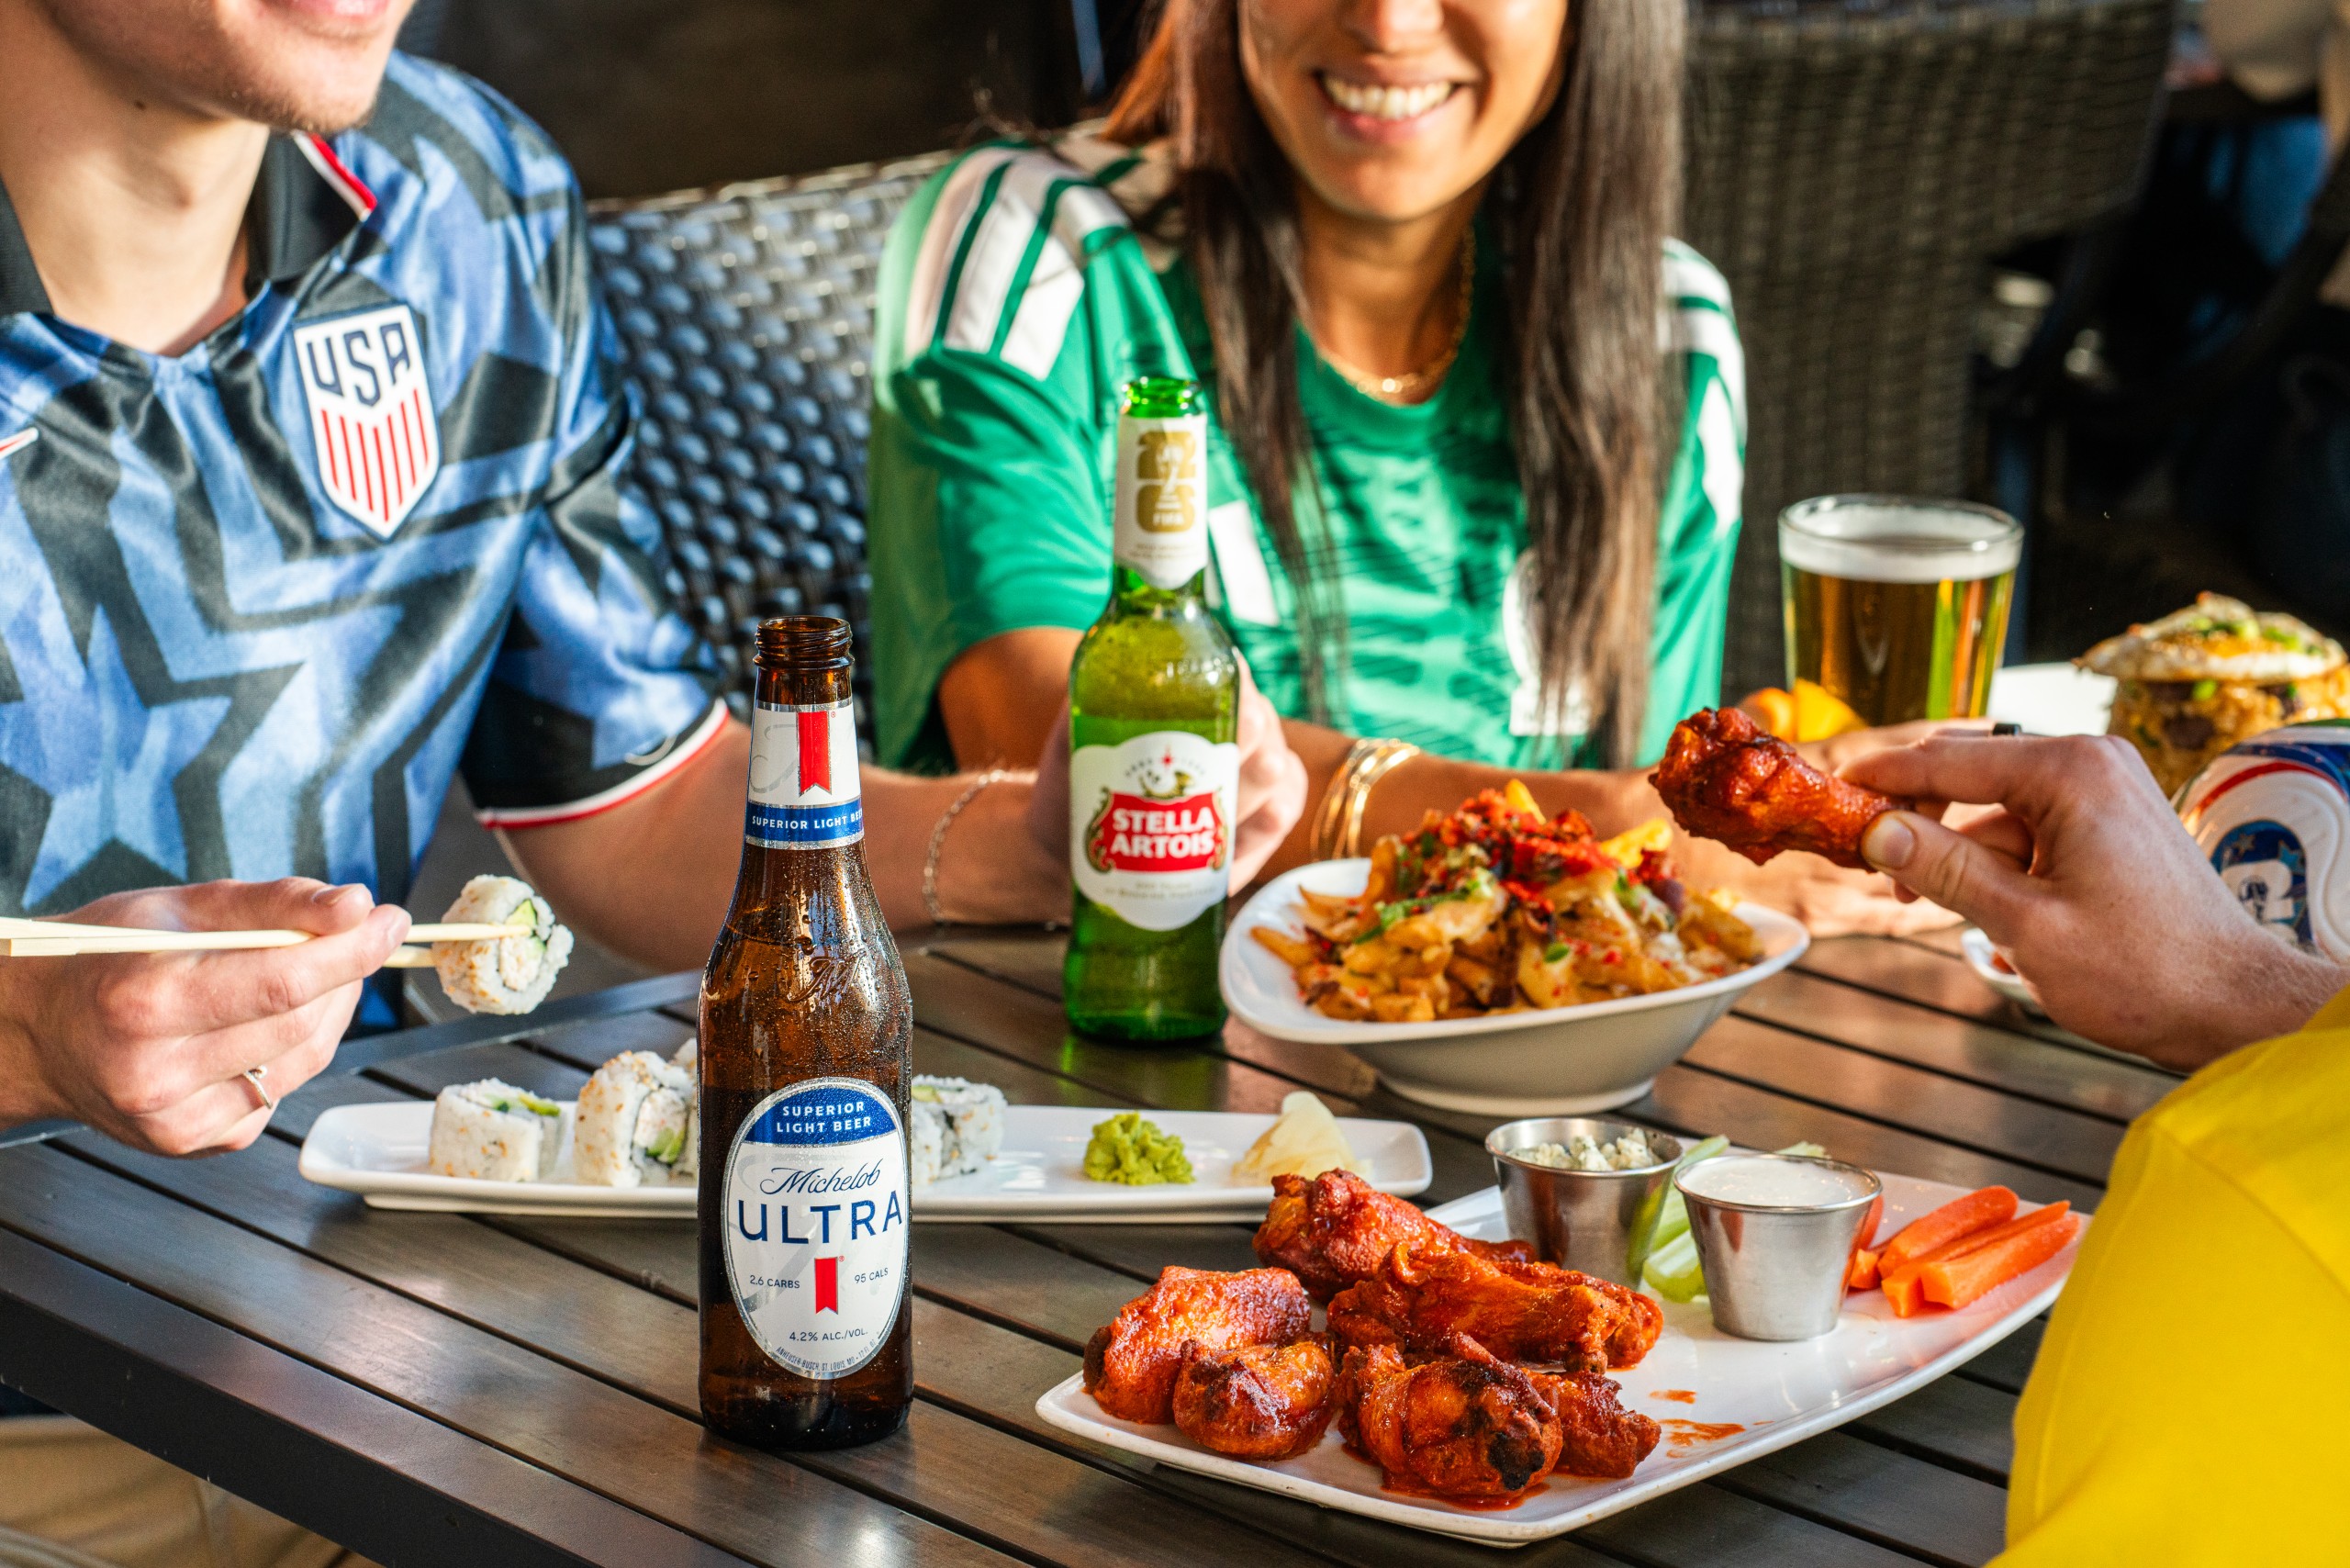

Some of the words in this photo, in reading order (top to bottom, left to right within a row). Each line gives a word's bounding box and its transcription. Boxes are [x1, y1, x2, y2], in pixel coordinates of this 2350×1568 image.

[307, 322, 410, 407] USA
[752, 815, 808, 830] SUPERIOR
[814, 815, 847, 829] LIGHT
[850, 808, 863, 823] BEE
[1113, 806, 1215, 834] STELLA
[1110, 830, 1216, 858] ARTOIS
[782, 1101, 865, 1117] SUPERIOR
[777, 1121, 824, 1134] LIGHT
[834, 1116, 871, 1132] BEER
[760, 1159, 883, 1195] Michelob
[738, 1190, 903, 1246] ULTRA
[749, 1274, 764, 1286] 2.6
[767, 1278, 800, 1289] CARBS
[855, 1273, 867, 1284] 95
[869, 1267, 890, 1282] CALS
[789, 1331, 818, 1341] 4.2%
[822, 1328, 868, 1341] ALC./VOL.
